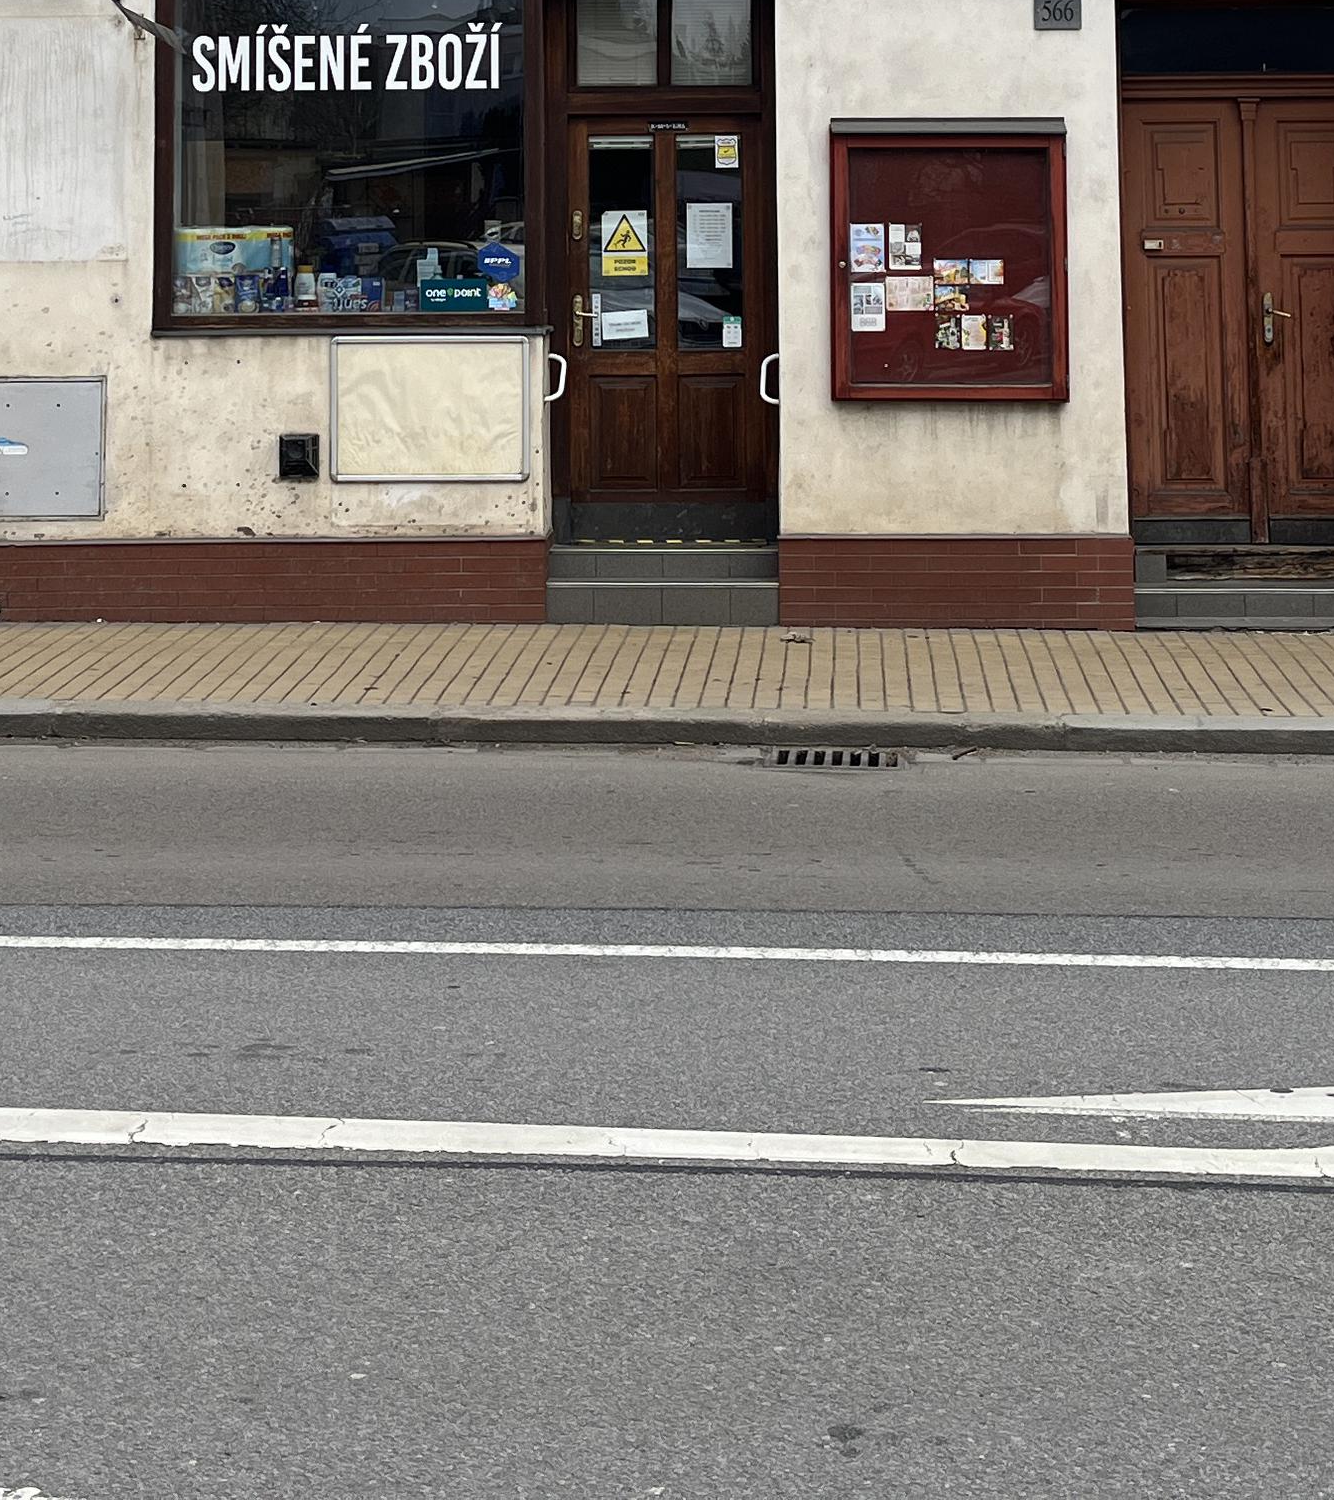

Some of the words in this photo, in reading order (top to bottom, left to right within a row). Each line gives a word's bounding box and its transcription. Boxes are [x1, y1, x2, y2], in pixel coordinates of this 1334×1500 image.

[1041, 0, 1074, 22] 566
[192, 23, 372, 92] SMÍŠENÉ
[385, 22, 503, 91] ZBOŽÍ
[425, 288, 447, 298] one
[453, 287, 482, 298] point
